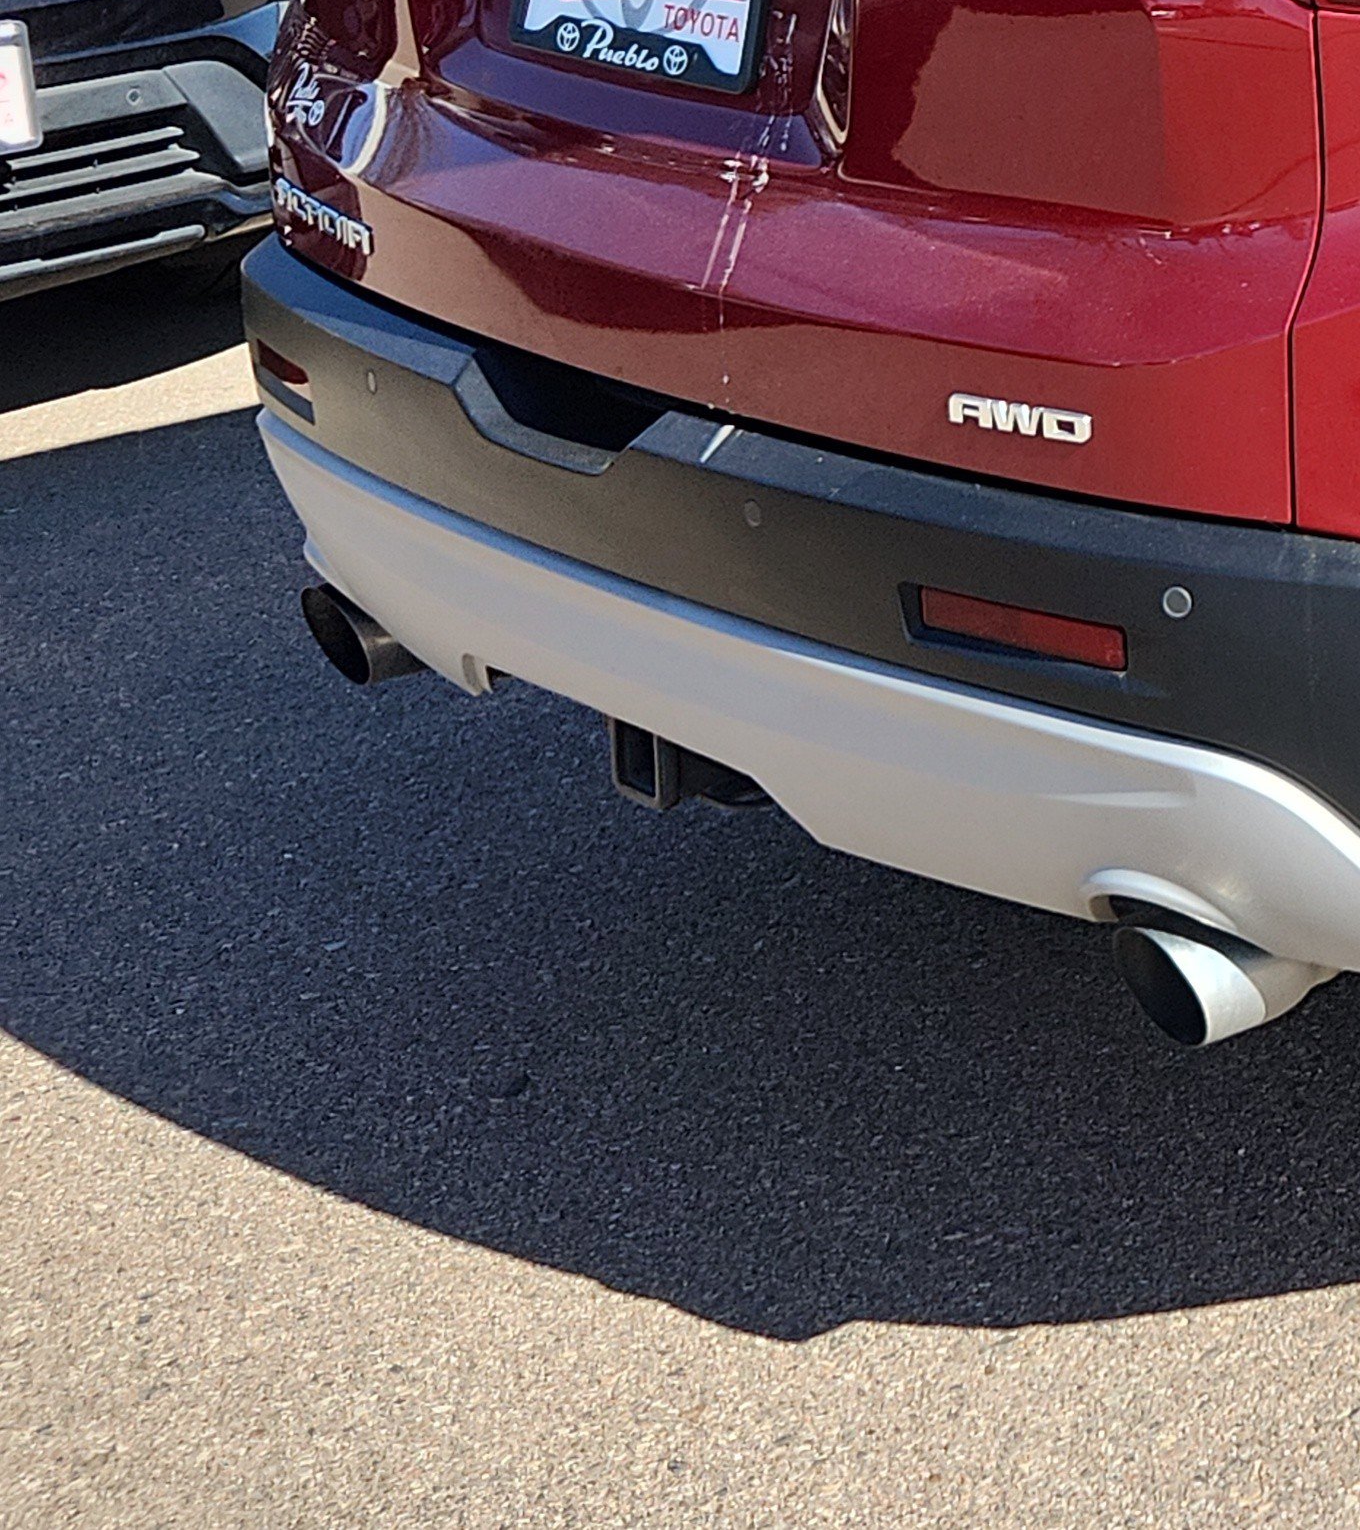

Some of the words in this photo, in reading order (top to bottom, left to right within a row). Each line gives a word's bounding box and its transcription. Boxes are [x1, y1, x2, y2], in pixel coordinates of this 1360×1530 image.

[580, 19, 660, 72] Pueblo
[663, 4, 741, 43] TOYOTA
[948, 392, 1093, 444] AWD
